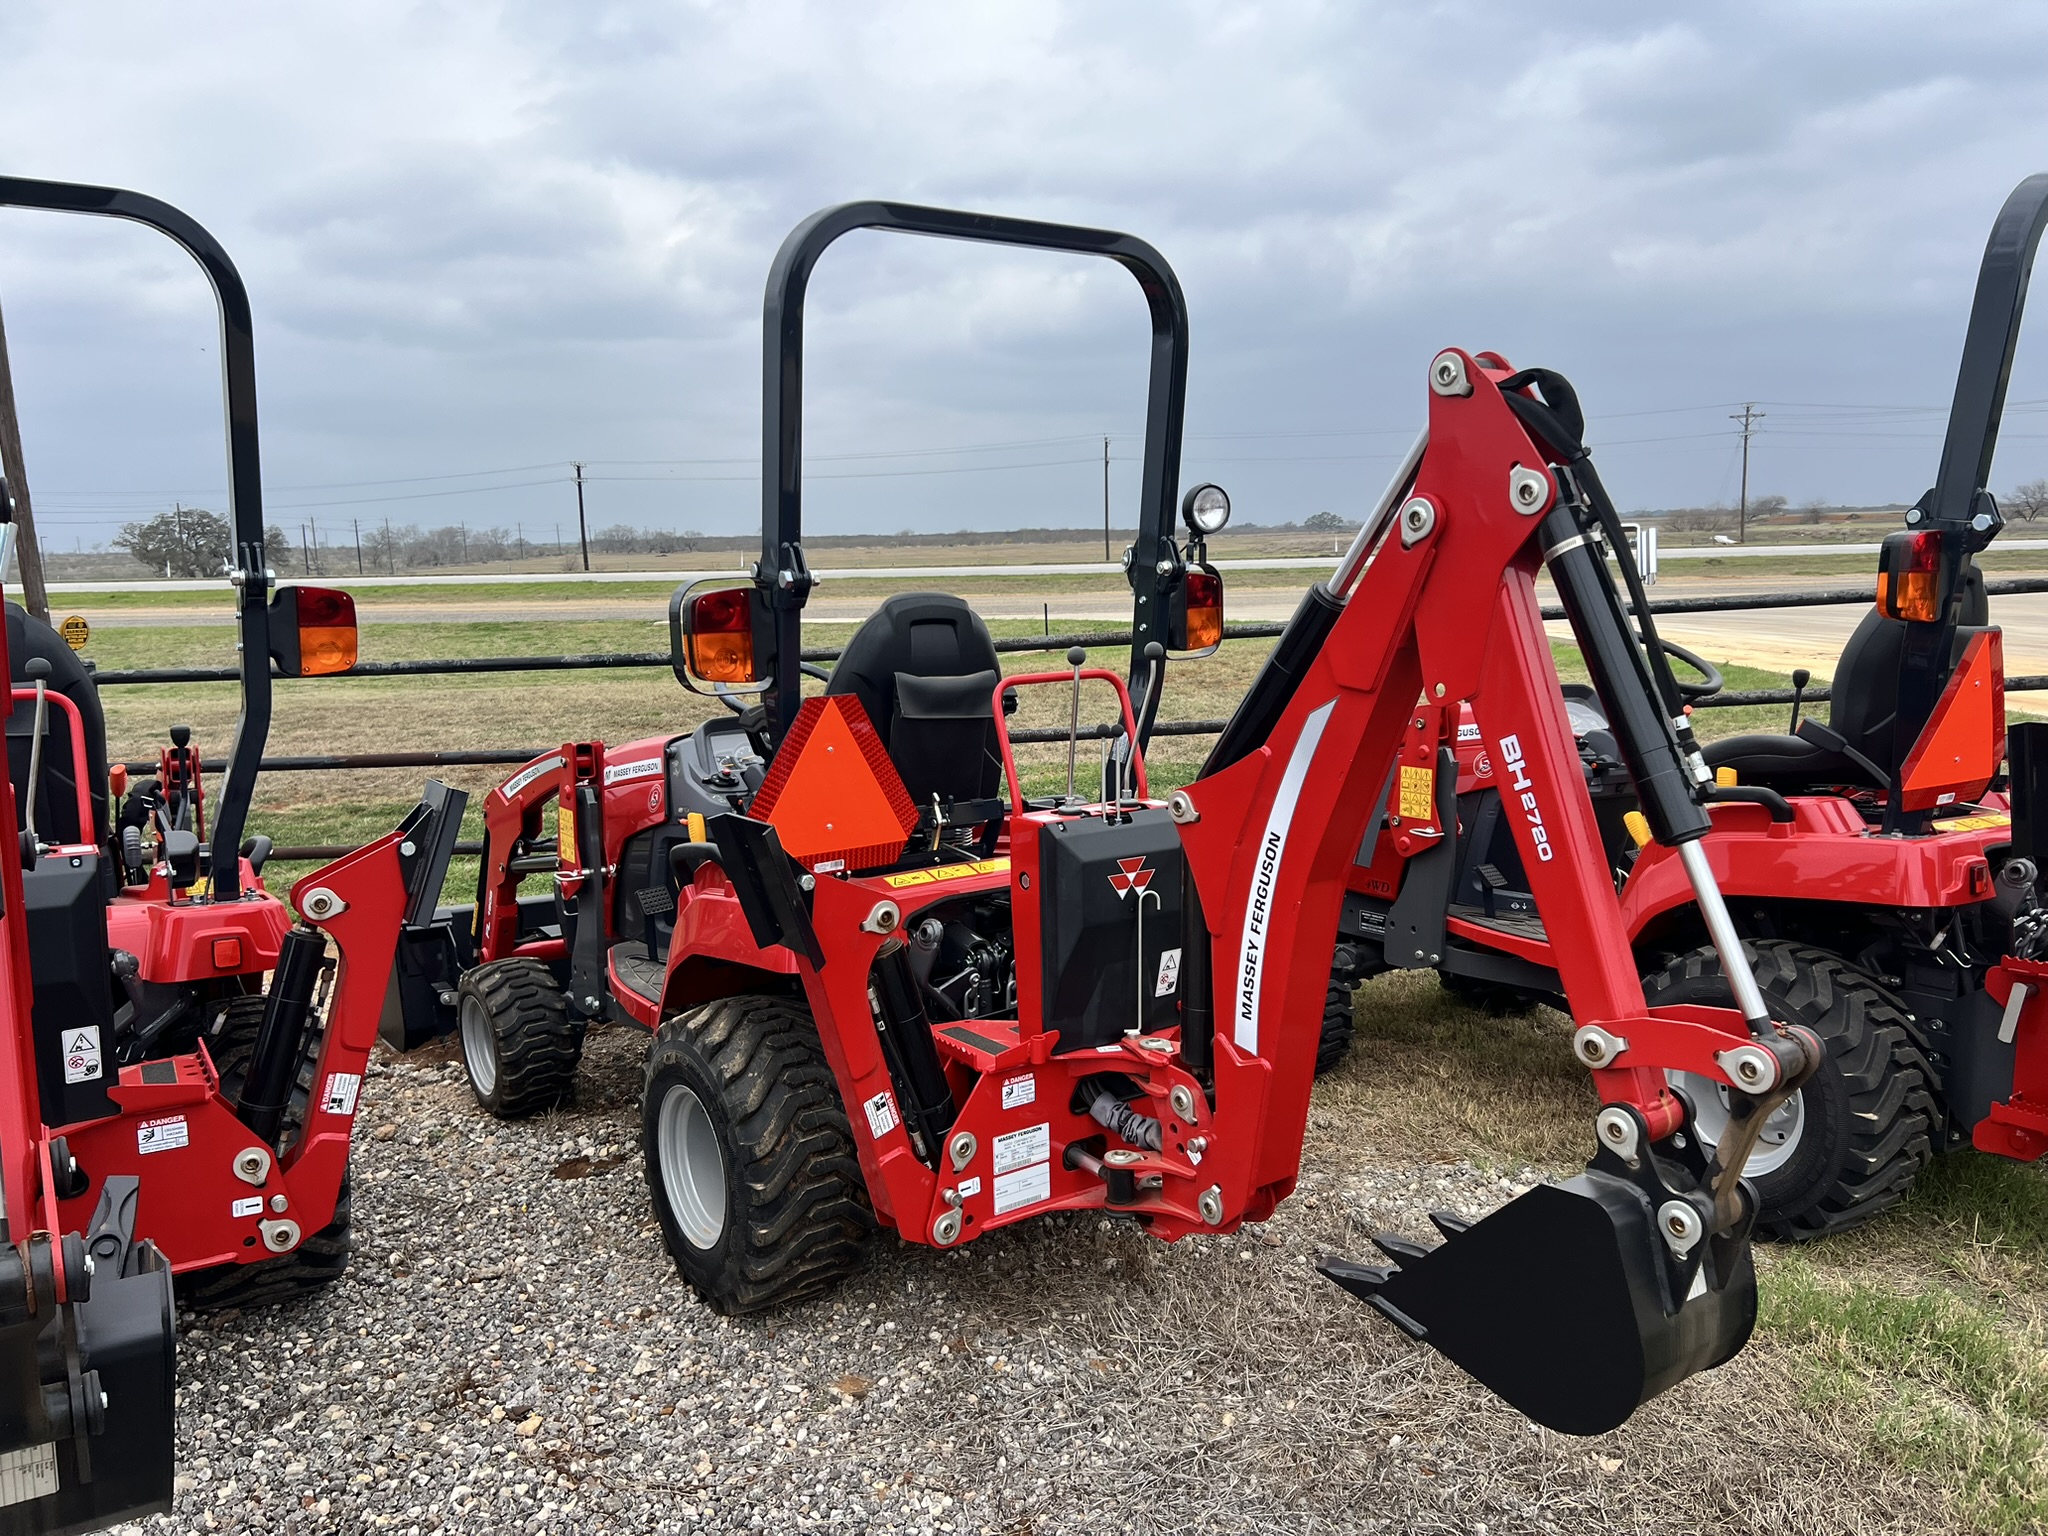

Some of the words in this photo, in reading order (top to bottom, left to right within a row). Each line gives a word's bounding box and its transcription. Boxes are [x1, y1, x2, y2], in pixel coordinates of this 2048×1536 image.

[613, 767, 631, 778] MASSEY
[632, 762, 659, 774] FERGUSON
[1499, 734, 1532, 791] BH
[1520, 792, 1553, 861] 2720
[1366, 879, 1390, 893] 4WD
[1241, 940, 1259, 1021] MASSEY
[1250, 831, 1281, 936] FERGUSON
[1010, 1072, 1034, 1084] DANGER
[322, 1074, 335, 1103] DANGER
[150, 1114, 185, 1127] DANGER
[886, 1099, 900, 1125] DANGER
[998, 1133, 1017, 1143] MASSEY
[1018, 1126, 1042, 1137] FERGUSON
